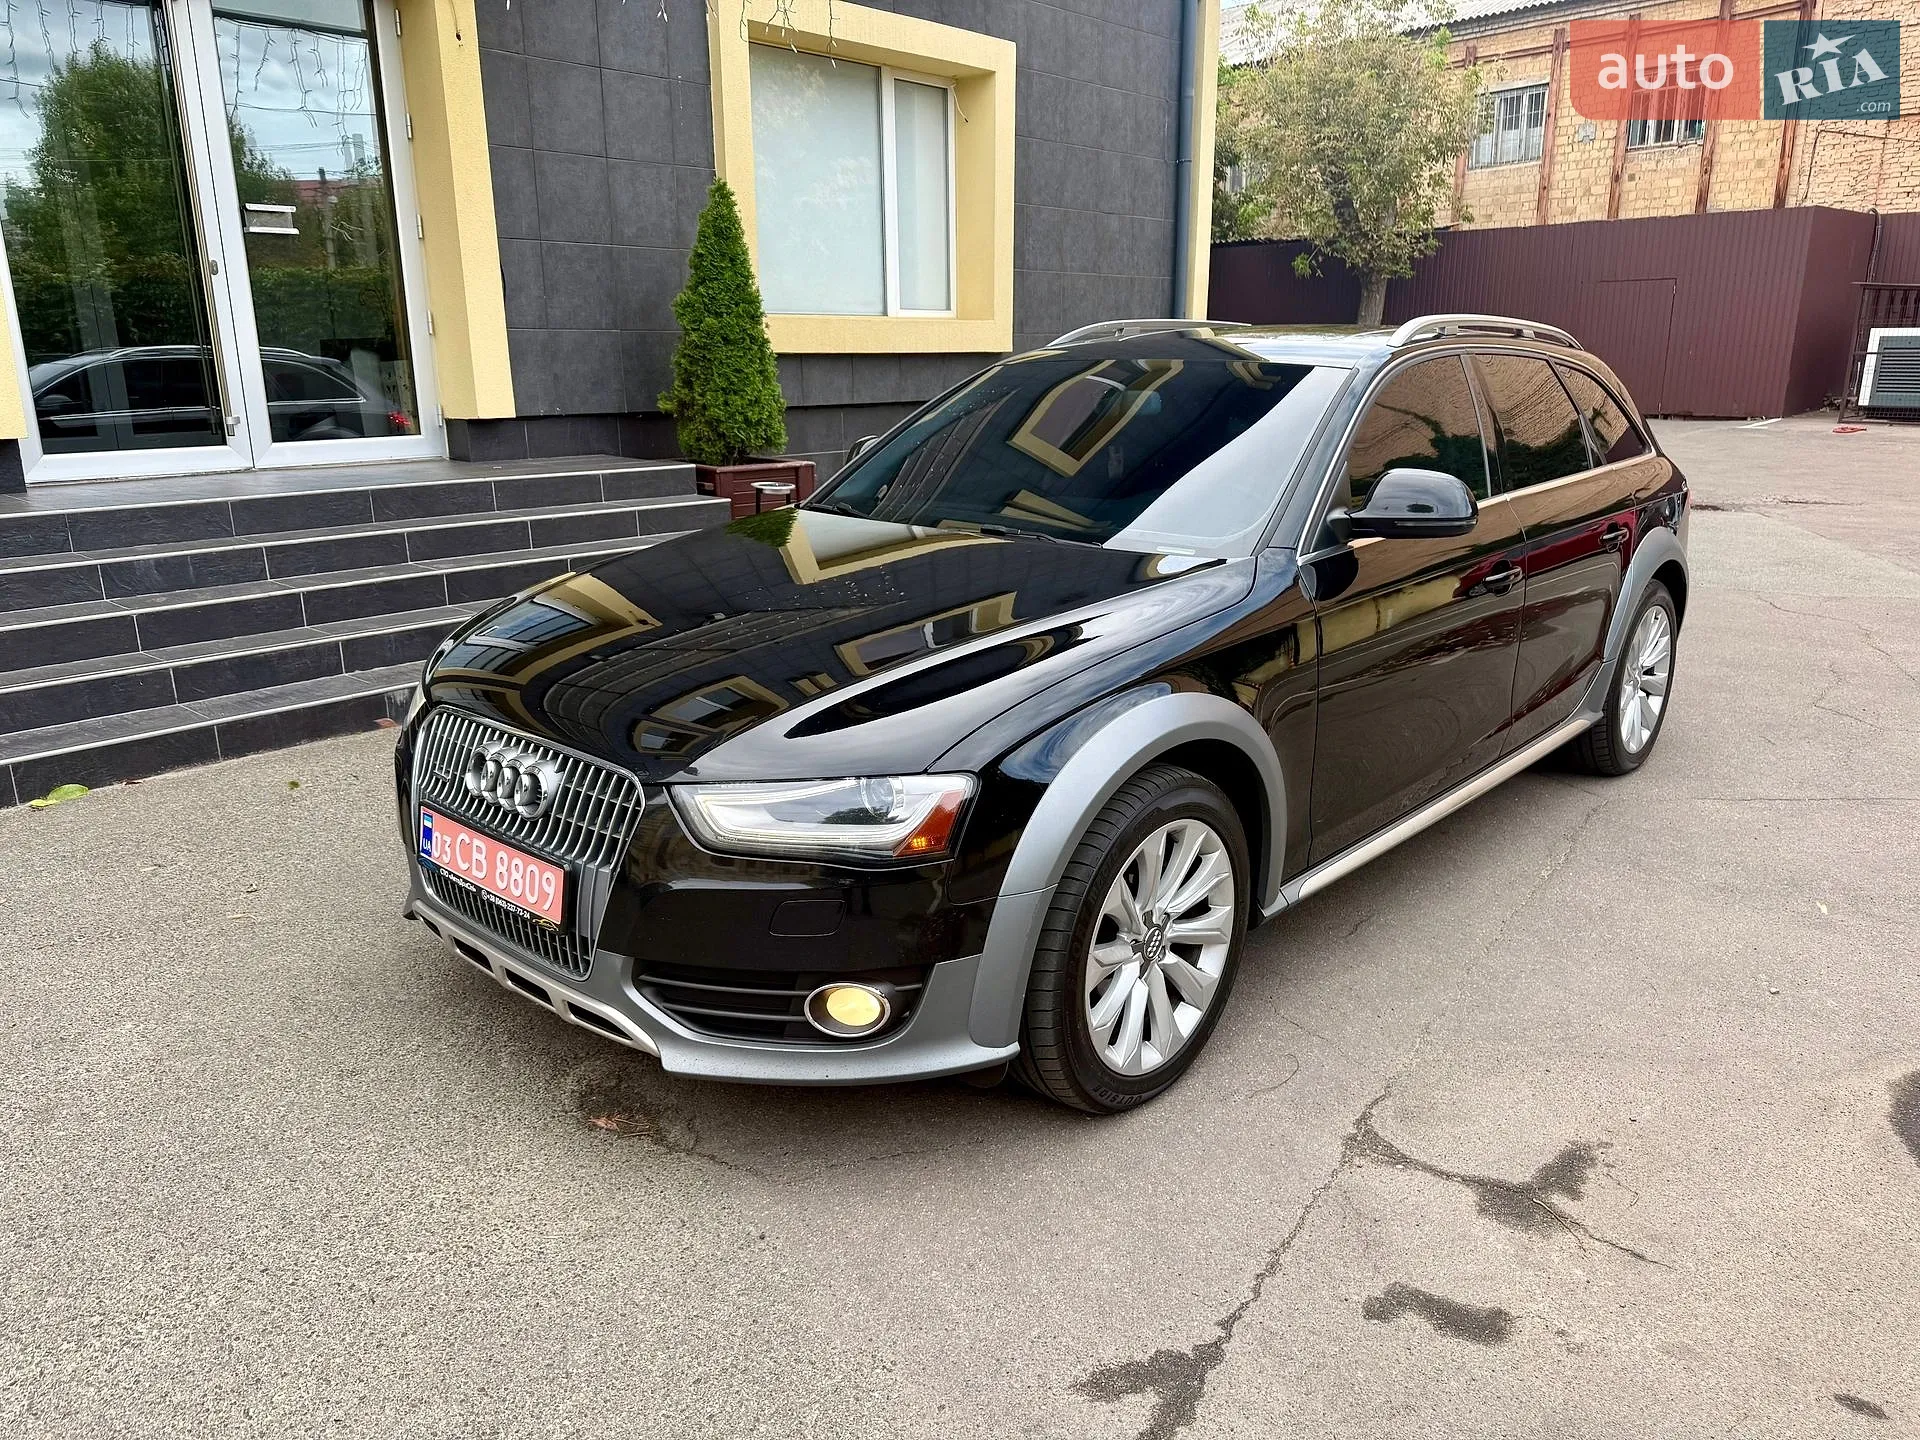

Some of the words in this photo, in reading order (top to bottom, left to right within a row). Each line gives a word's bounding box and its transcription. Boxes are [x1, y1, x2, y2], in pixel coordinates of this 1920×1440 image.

[423, 838, 431, 850] UA
[432, 831, 452, 864] 03
[455, 833, 487, 879] CB
[495, 850, 556, 911] 8809
